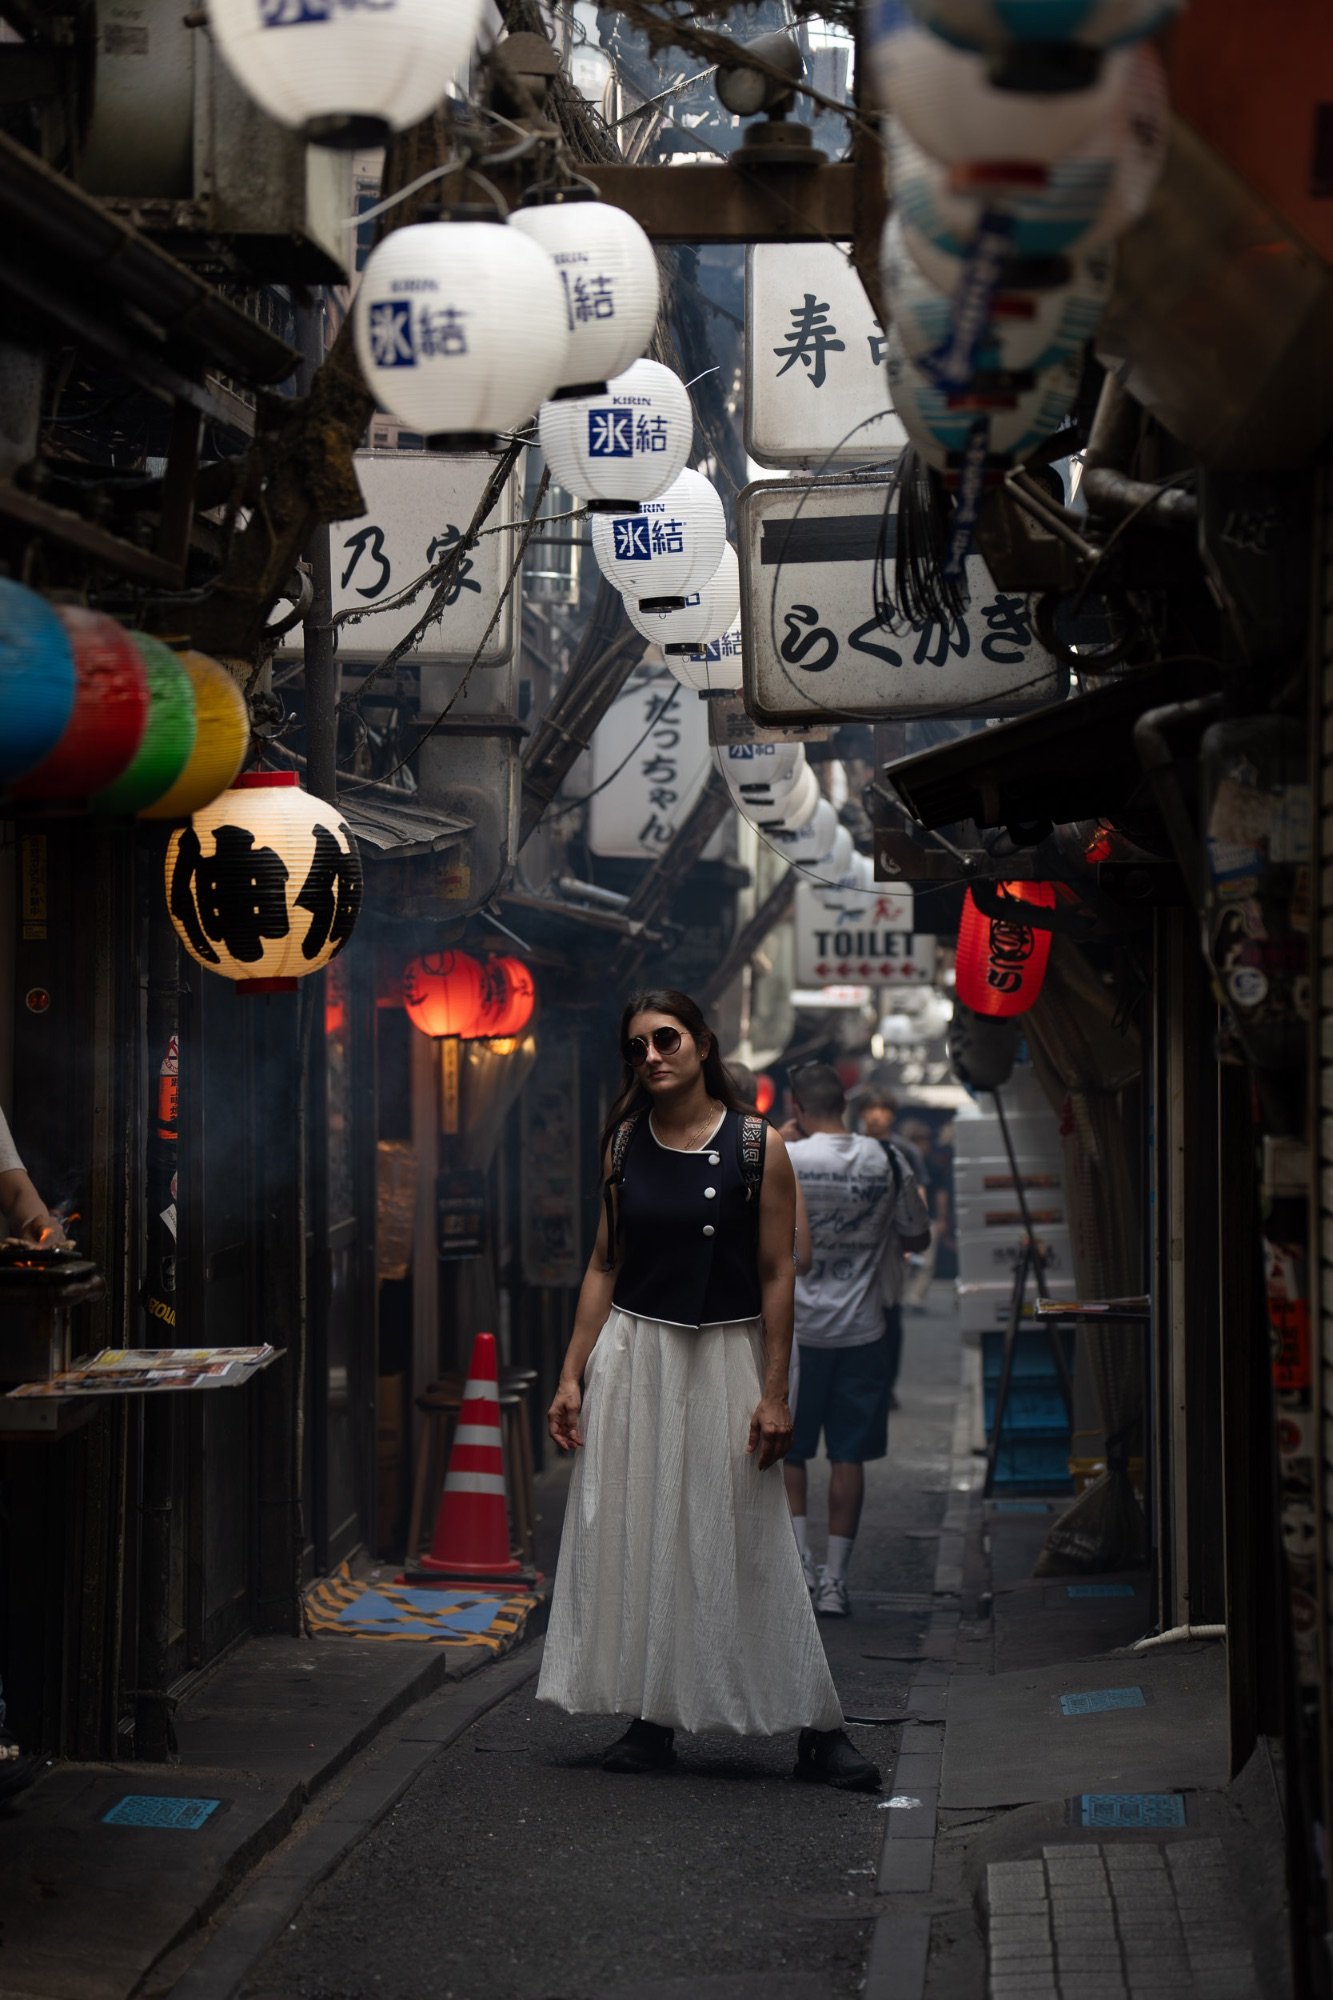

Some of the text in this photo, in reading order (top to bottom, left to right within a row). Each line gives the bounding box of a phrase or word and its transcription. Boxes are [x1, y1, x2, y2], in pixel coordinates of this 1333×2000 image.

[370, 301, 468, 368] 氷結
[612, 396, 651, 406] KIRIN
[588, 408, 668, 458] 氷結
[639, 503, 665, 513] IRIN
[613, 516, 684, 560] 氷結
[639, 694, 681, 846] たっちゃん
[813, 931, 916, 957] TOILET
